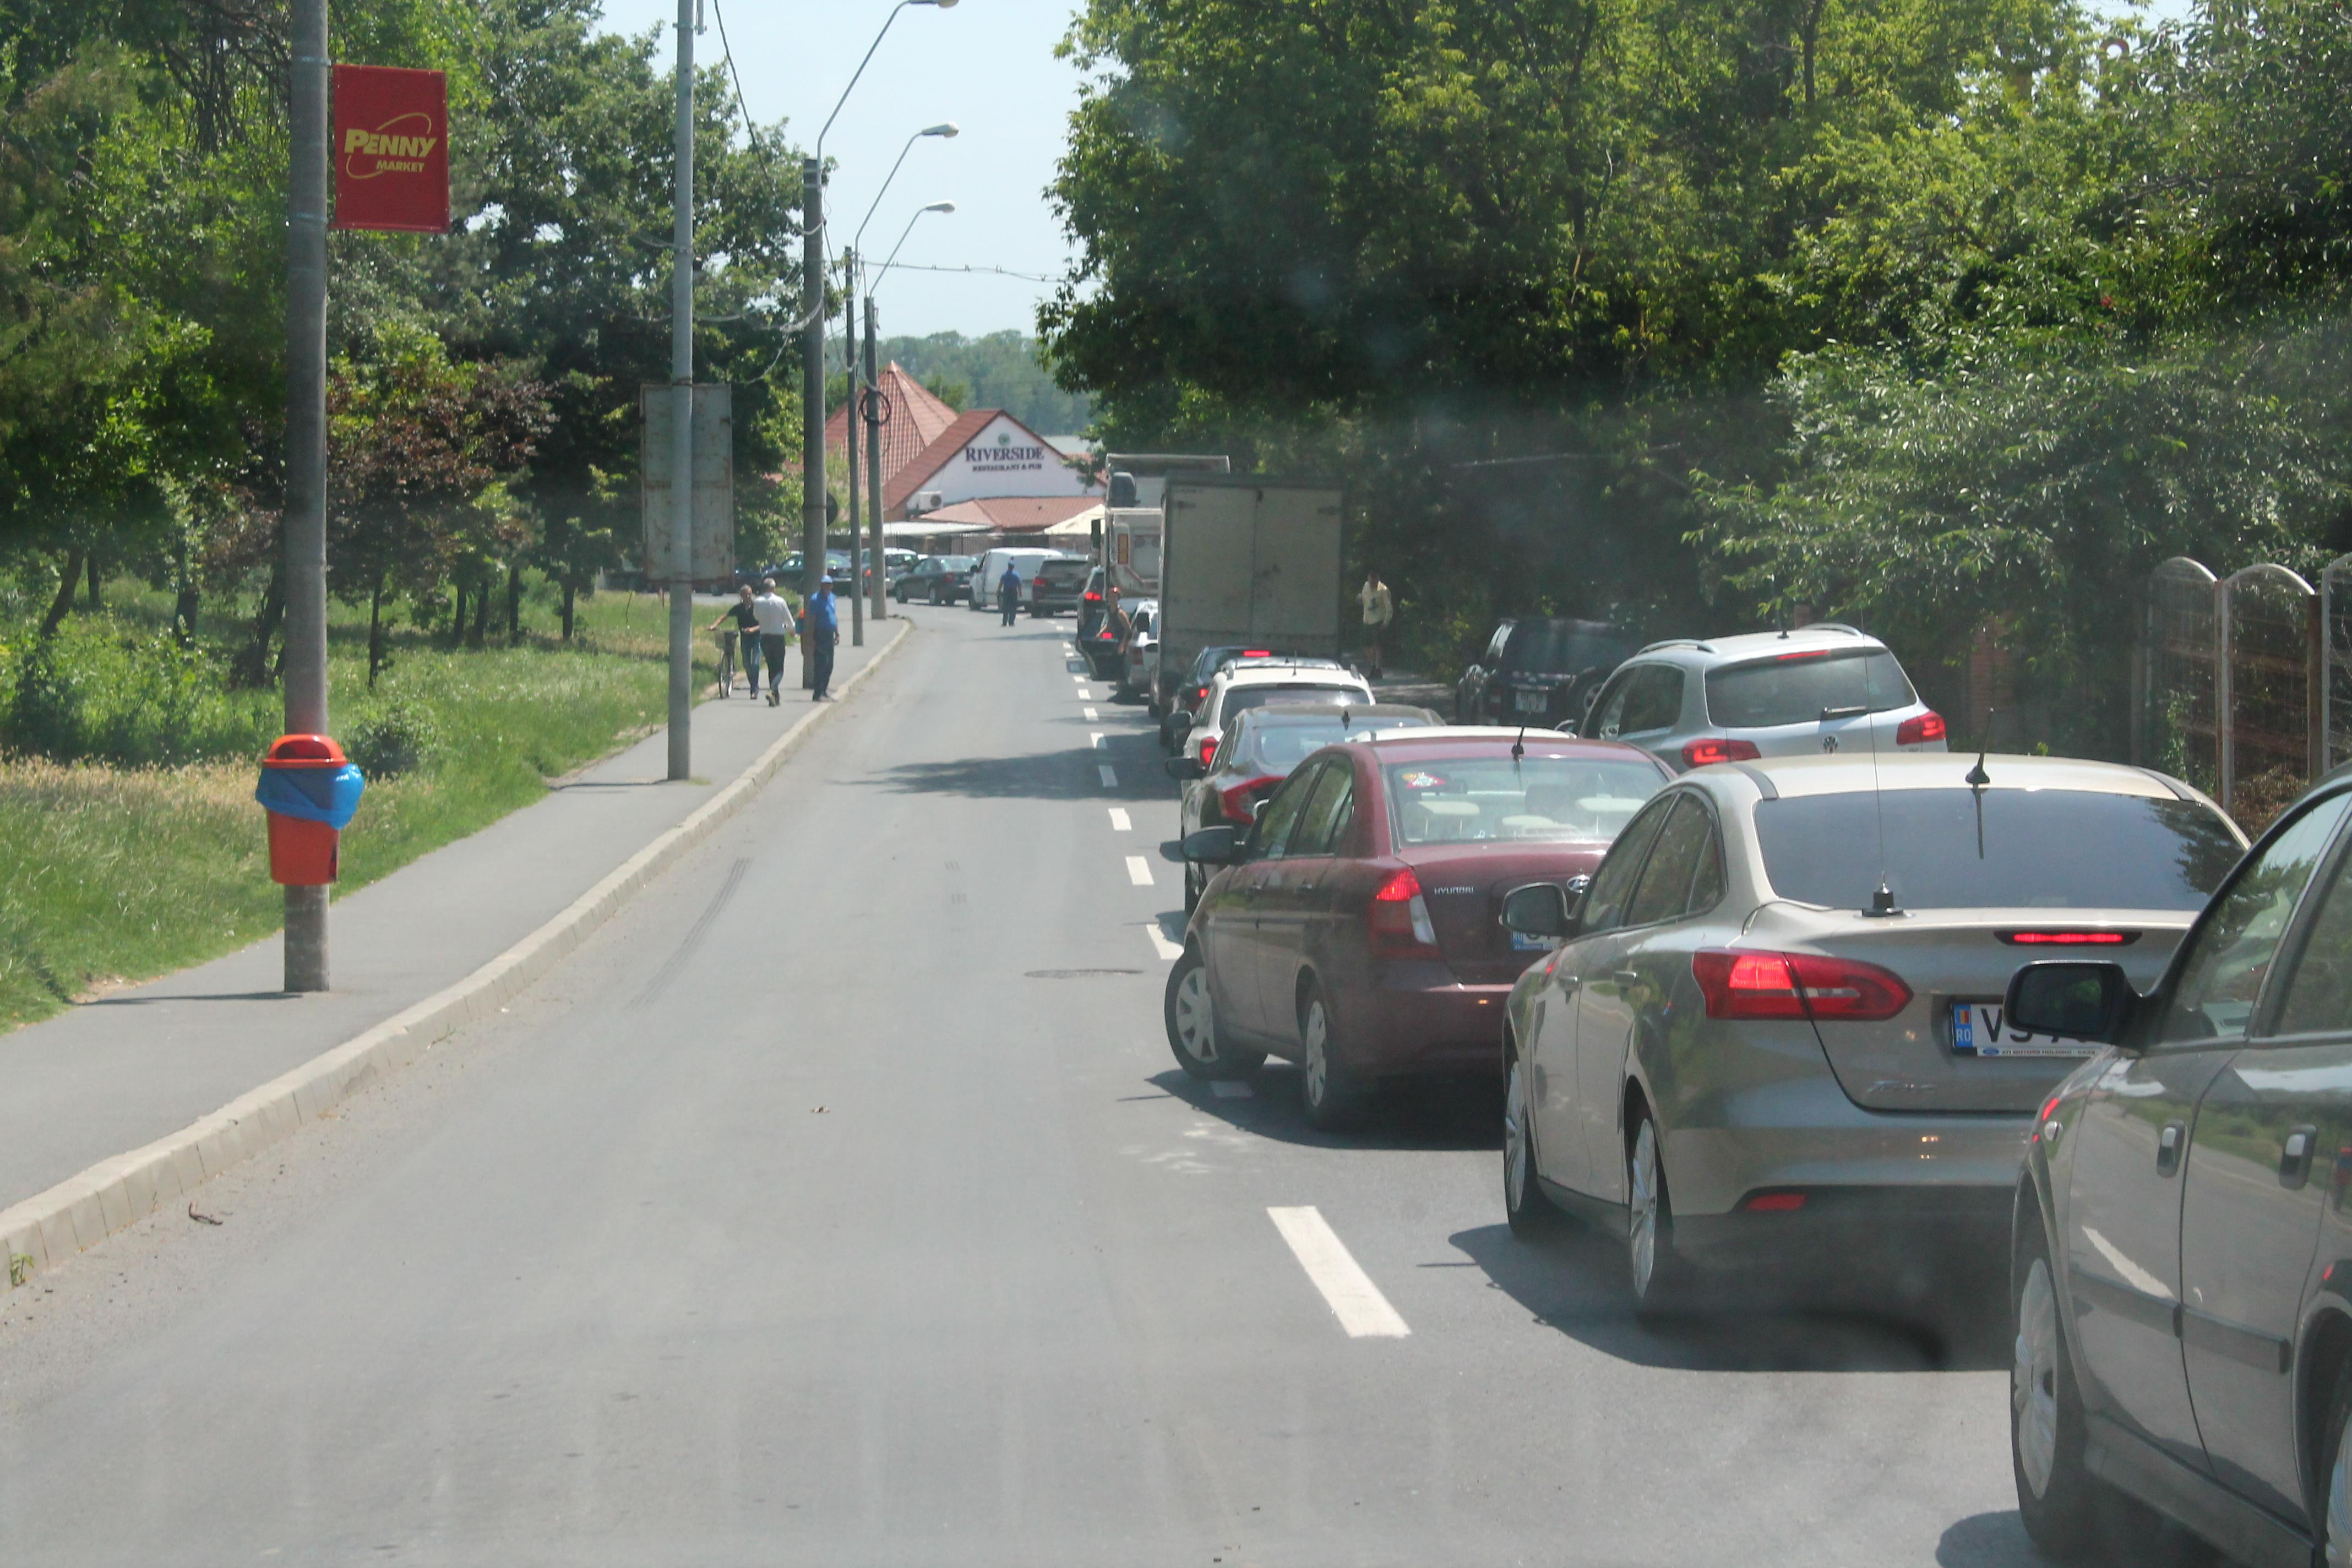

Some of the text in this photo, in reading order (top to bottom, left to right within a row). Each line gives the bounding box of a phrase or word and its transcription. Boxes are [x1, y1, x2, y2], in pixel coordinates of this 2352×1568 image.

[344, 128, 437, 157] PENNY
[376, 160, 425, 173] MARKET
[966, 447, 1044, 462] RIVERSIDE
[1434, 886, 1474, 895] HYUNDAI
[1956, 1028, 1971, 1042] RO
